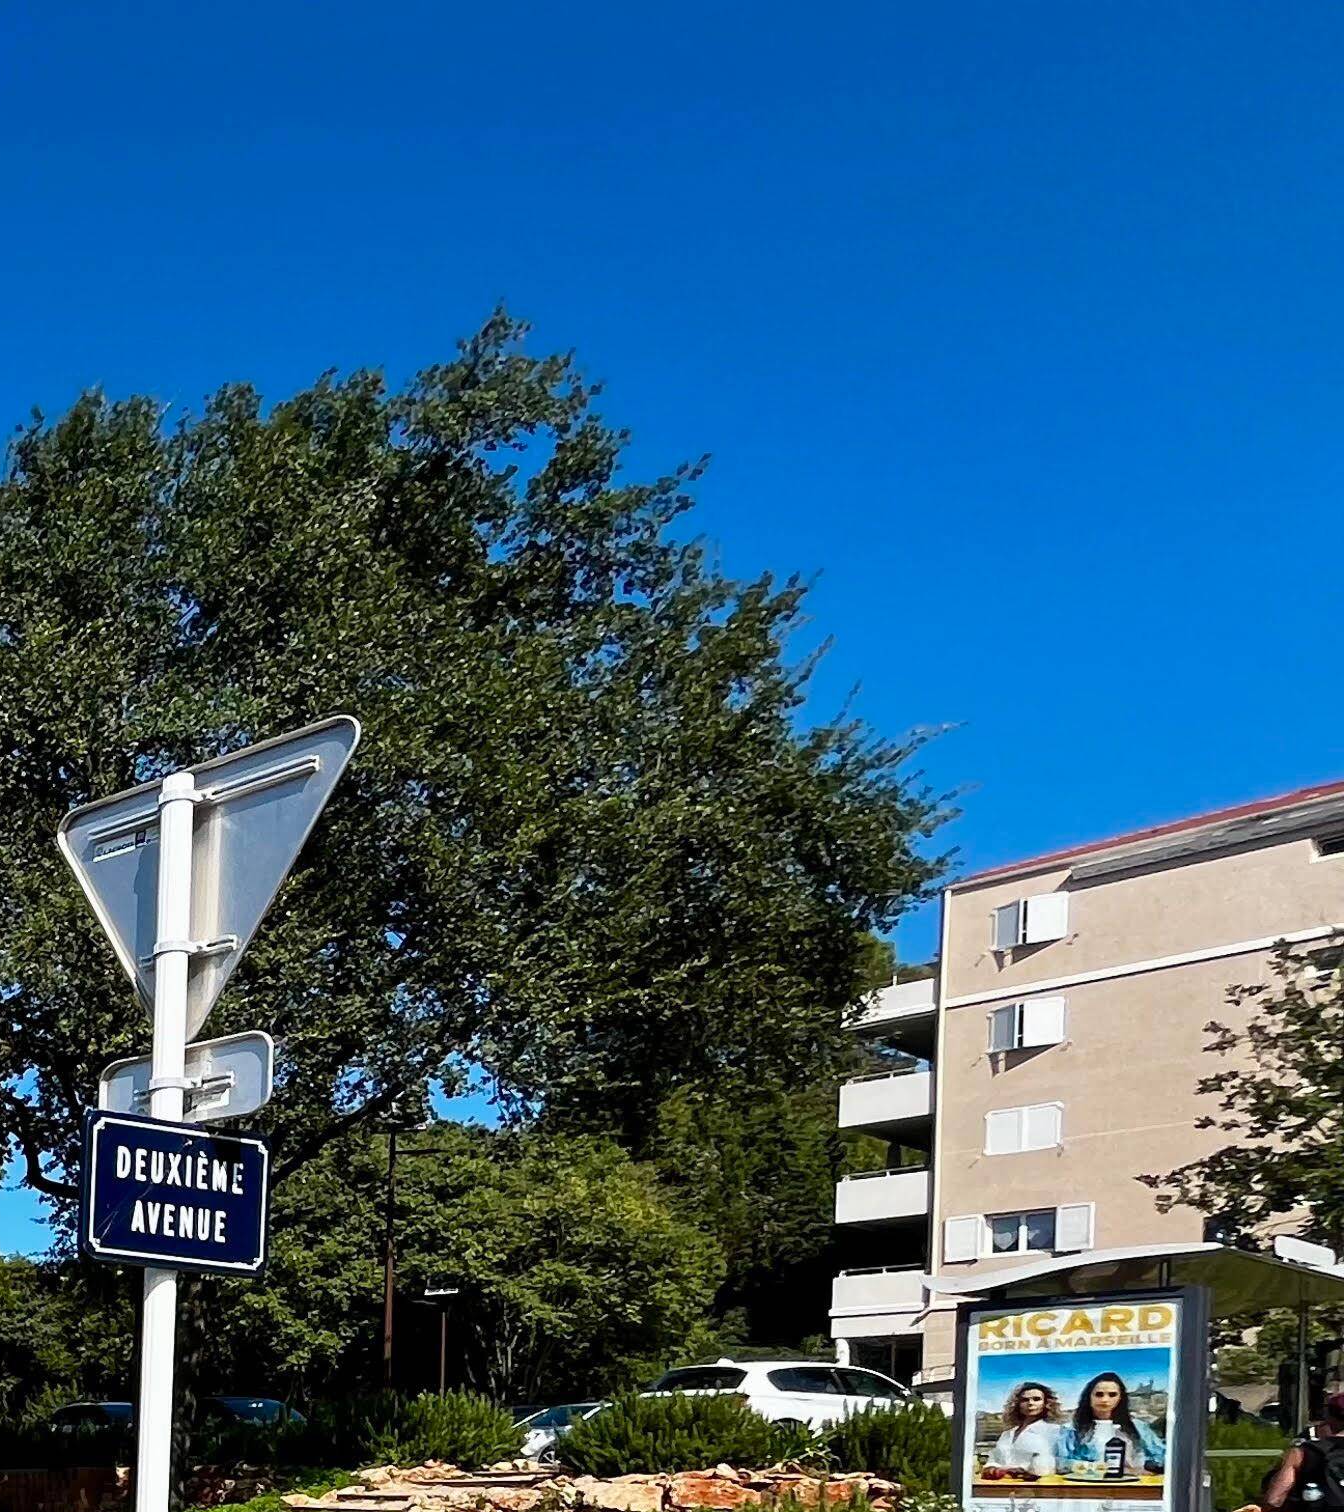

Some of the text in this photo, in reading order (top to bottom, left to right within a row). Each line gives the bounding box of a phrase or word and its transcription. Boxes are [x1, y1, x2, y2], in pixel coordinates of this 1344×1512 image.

[115, 1145, 245, 1196] DEUXIÈME
[130, 1200, 227, 1244] AVENUE
[979, 1306, 1173, 1339] RICARD
[978, 1340, 1031, 1352] BORN
[1054, 1332, 1172, 1348] MARSEILLE
